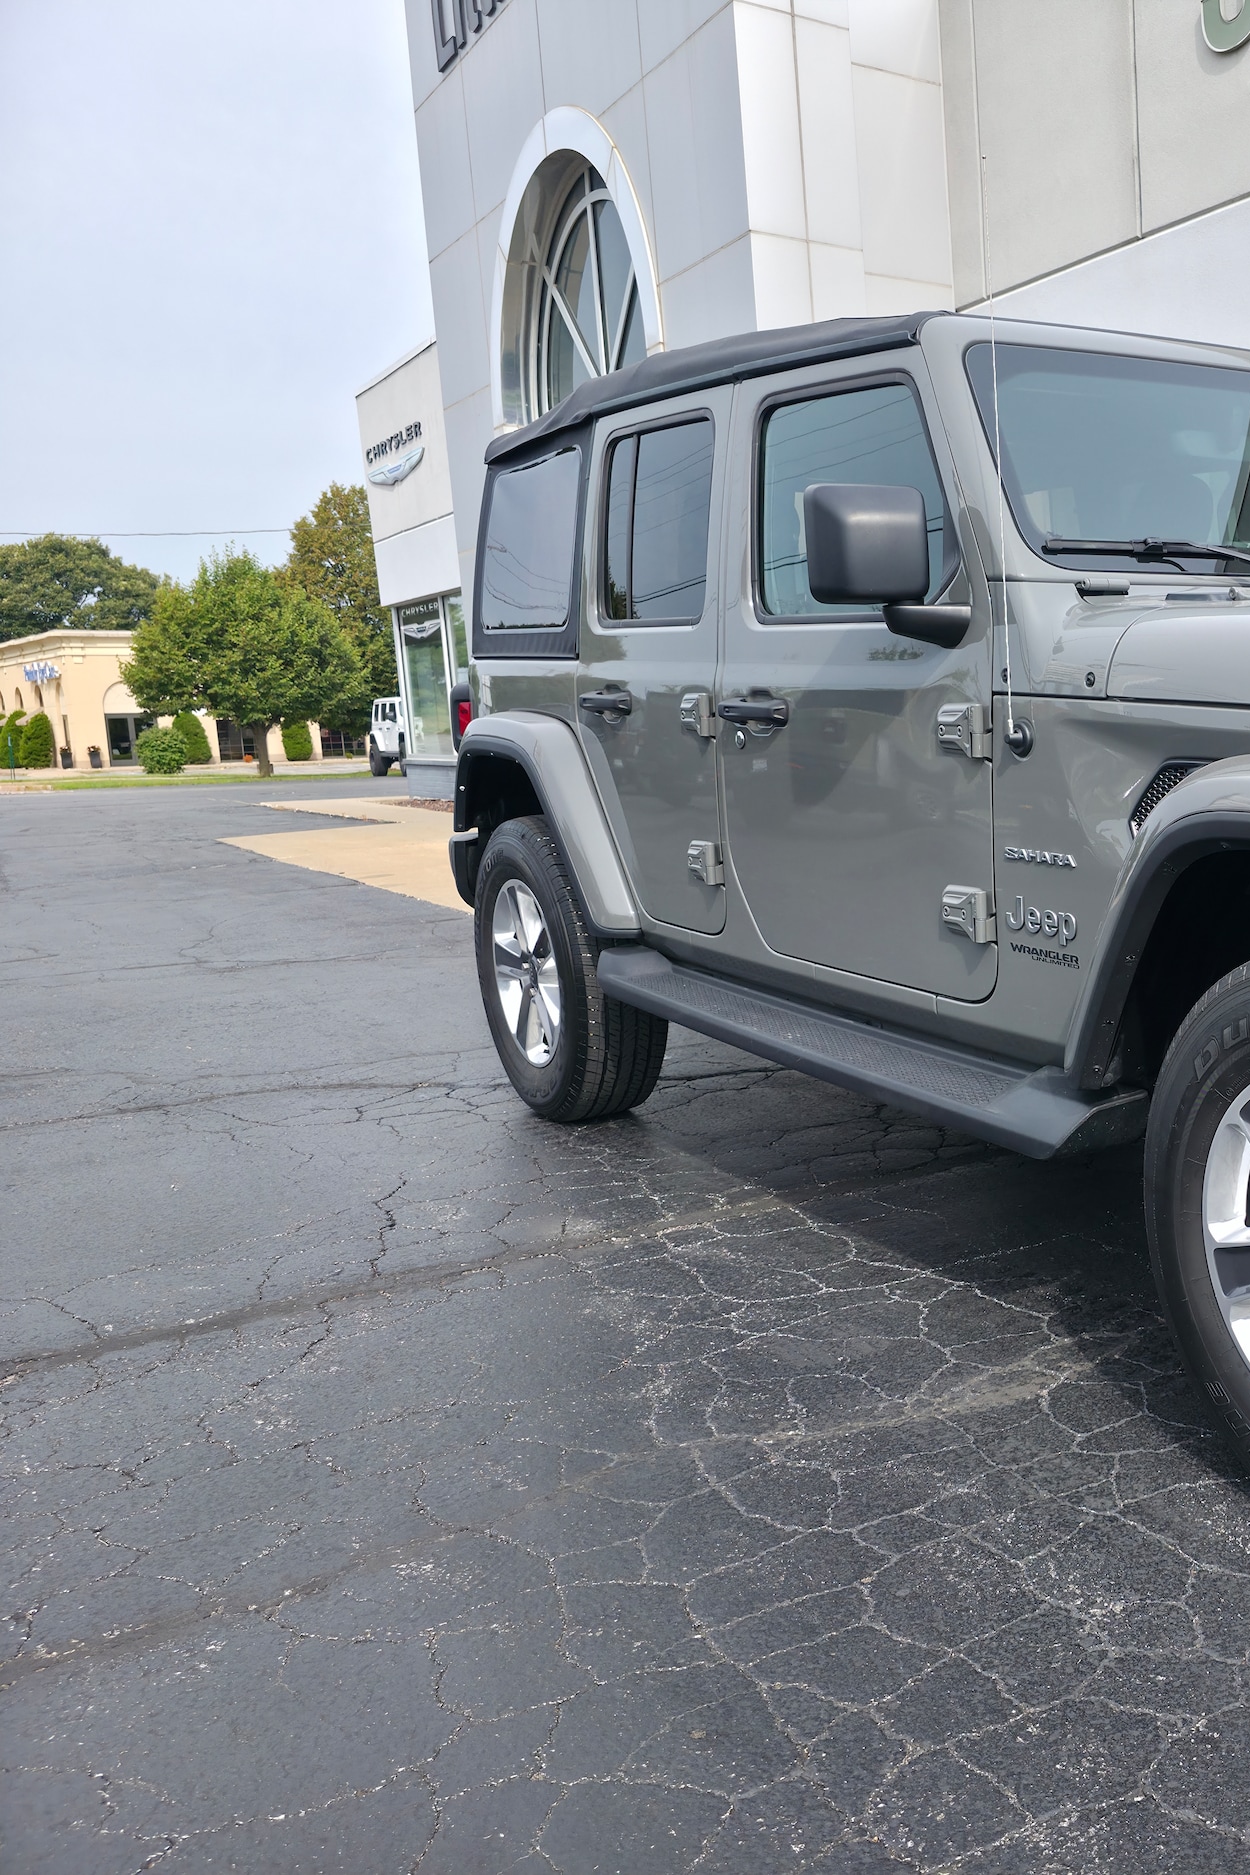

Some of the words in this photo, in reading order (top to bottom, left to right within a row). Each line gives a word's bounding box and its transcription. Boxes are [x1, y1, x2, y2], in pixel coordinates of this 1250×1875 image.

[366, 421, 422, 464] CHRYSLER
[401, 601, 439, 618] CHRYSLER
[1005, 846, 1077, 868] SAHARA
[1006, 895, 1077, 947] Jeep
[1010, 942, 1079, 964] WRANGLER
[1031, 955, 1080, 970] UNLIMITED
